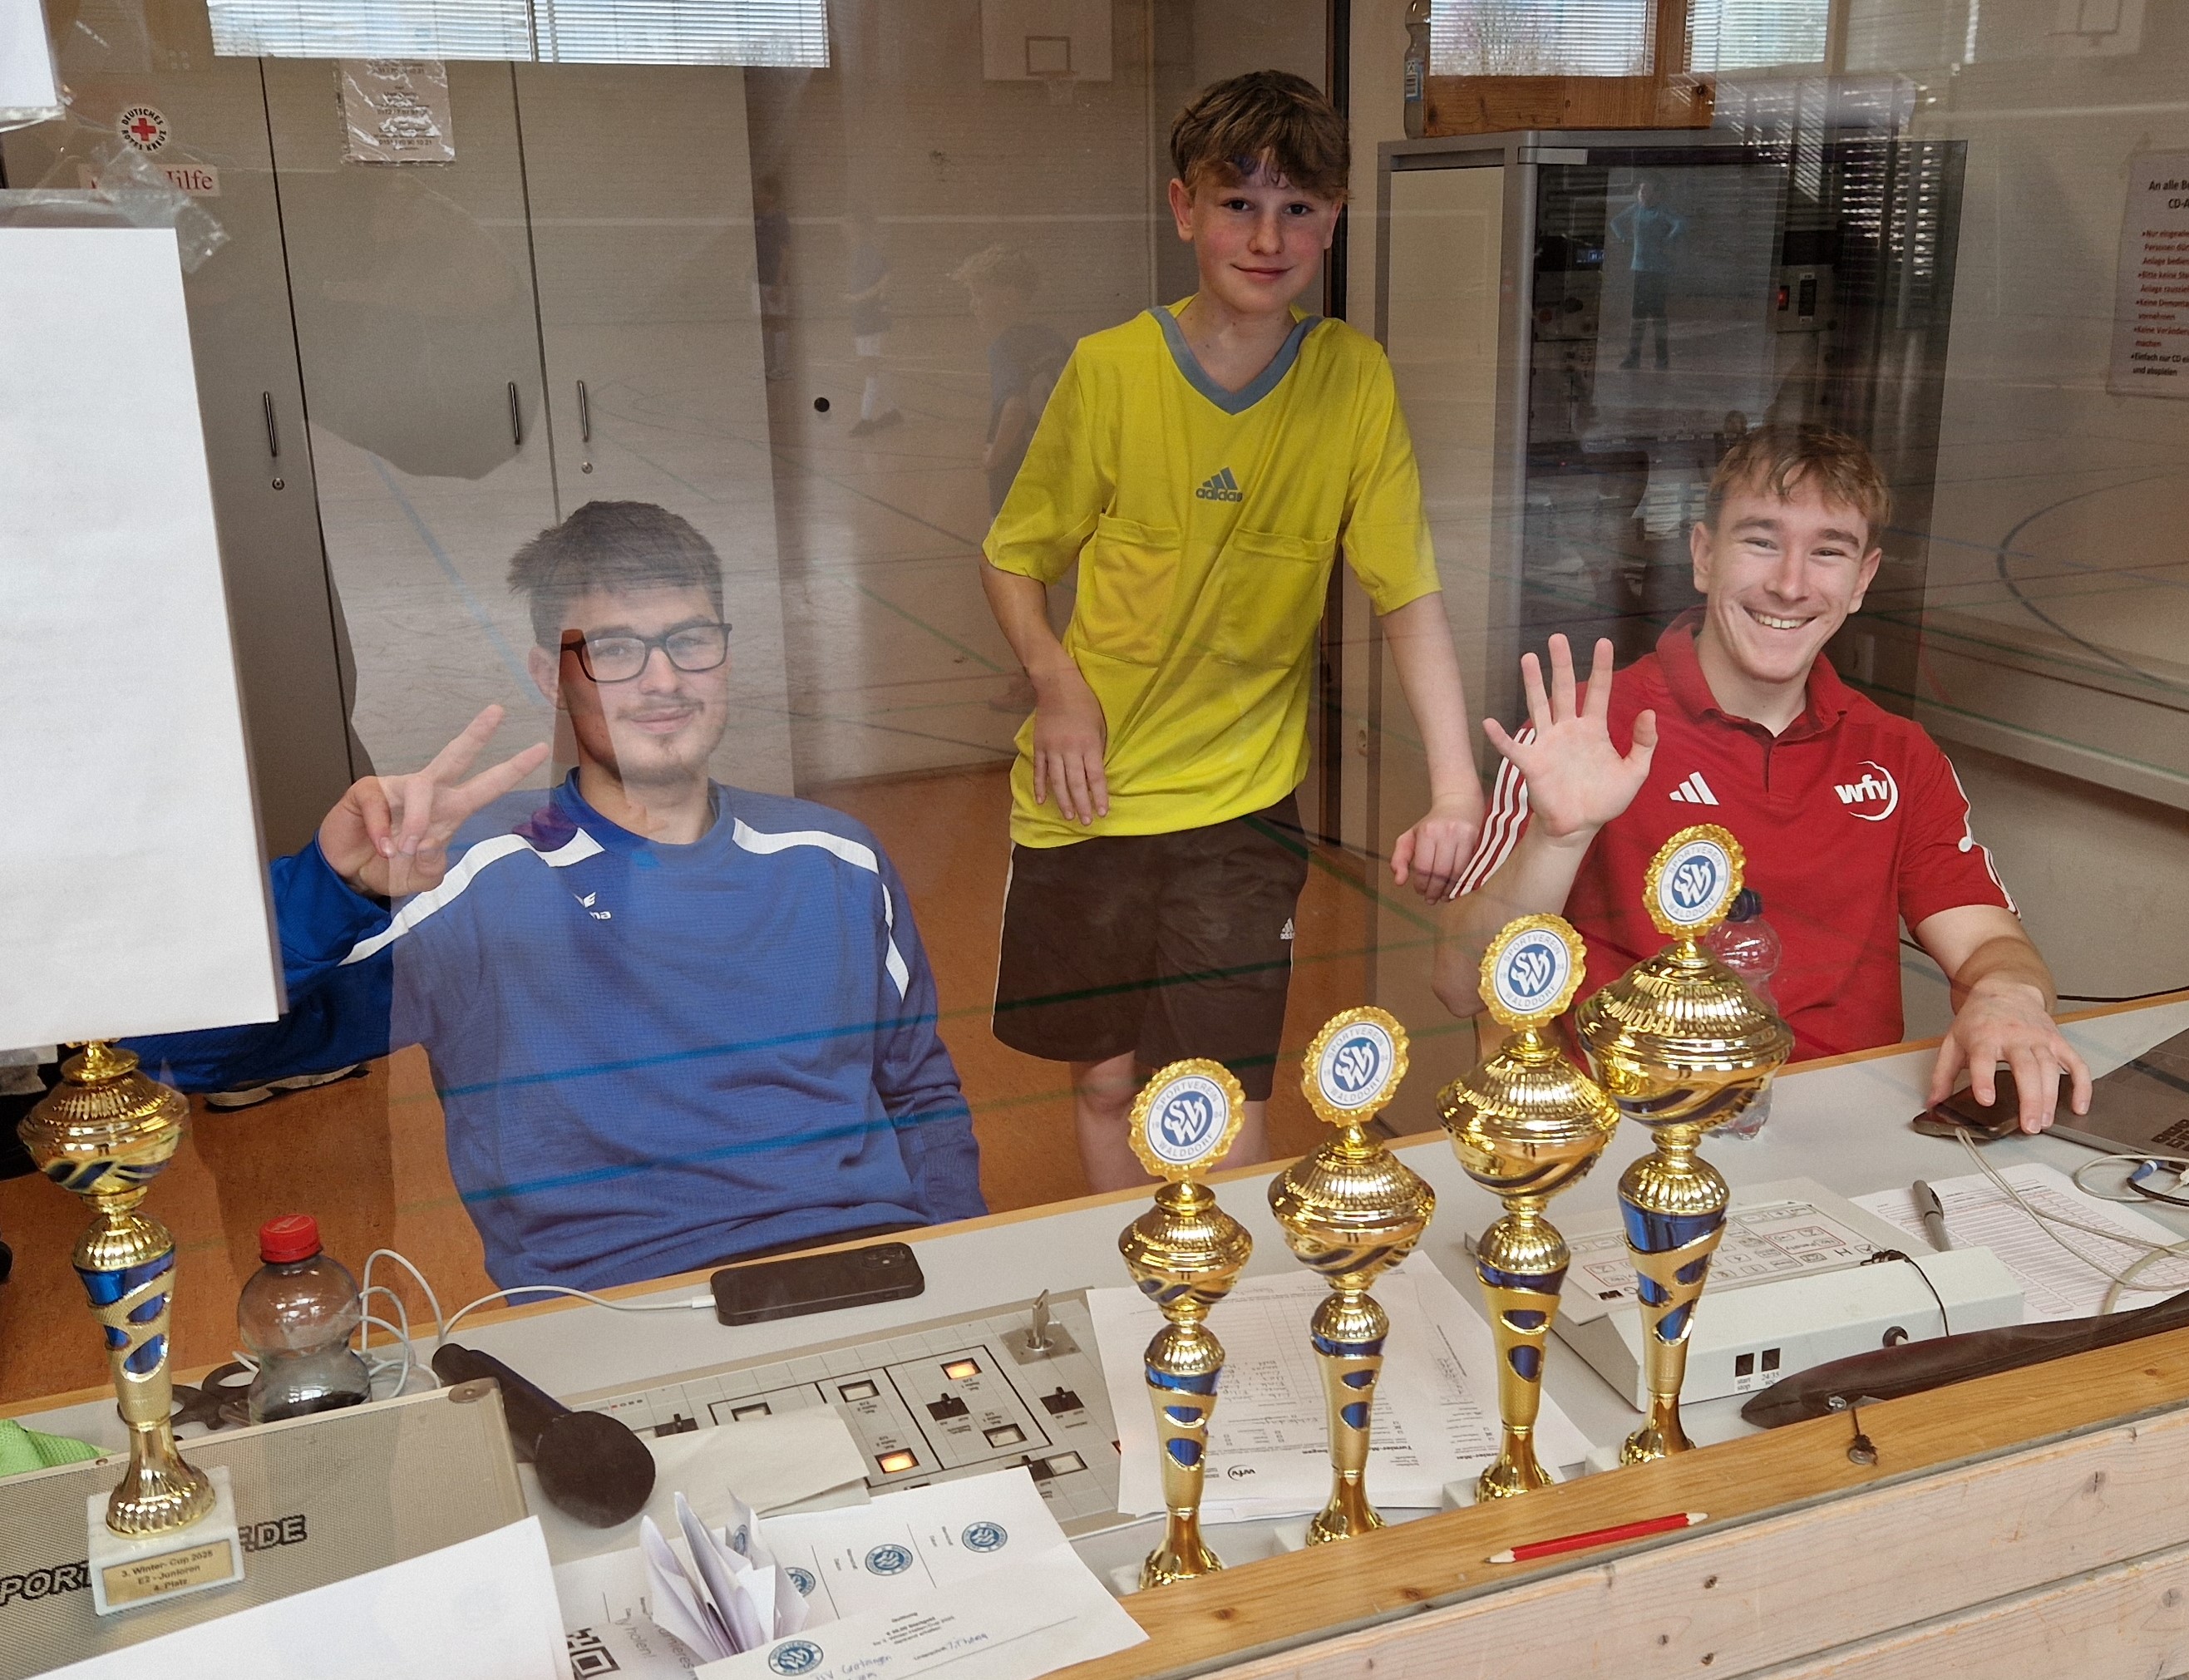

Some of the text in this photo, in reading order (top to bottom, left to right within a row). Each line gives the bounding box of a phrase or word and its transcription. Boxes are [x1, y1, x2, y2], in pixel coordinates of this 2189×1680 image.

[121, 108, 164, 126] DEUTSCHES
[121, 130, 166, 151] ROTES KREUZ
[2148, 180, 2161, 190] An
[2163, 180, 2179, 190] alle
[2134, 352, 2158, 362] Einfach
[1196, 488, 1243, 502] adidas
[1833, 774, 1888, 804] wfv
[169, 1557, 190, 1566] Cup
